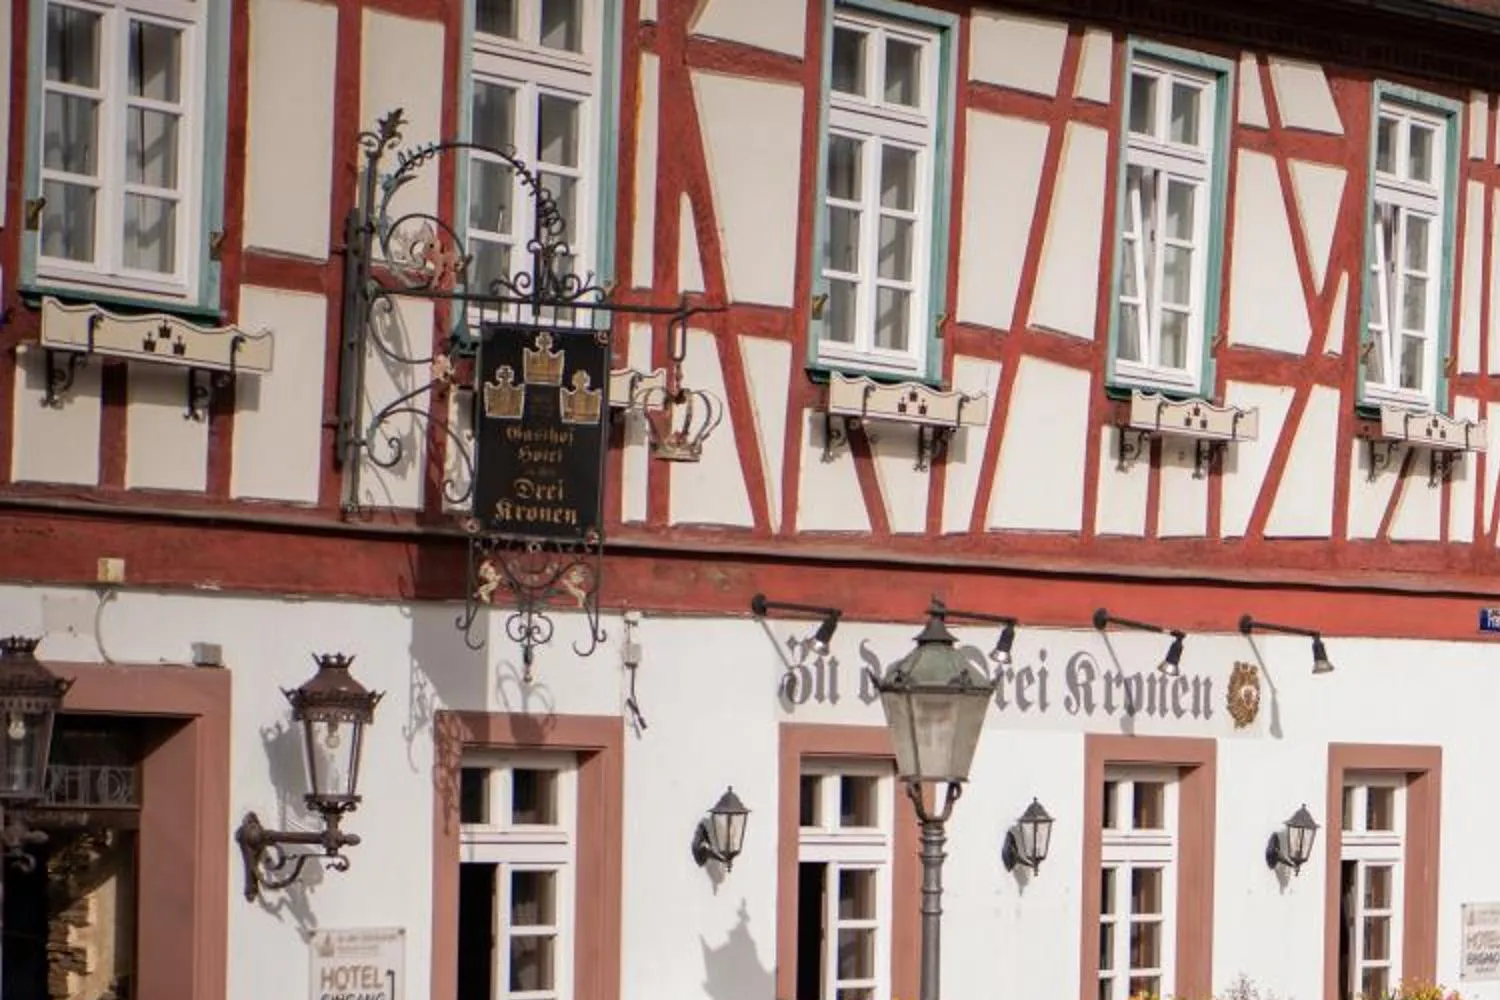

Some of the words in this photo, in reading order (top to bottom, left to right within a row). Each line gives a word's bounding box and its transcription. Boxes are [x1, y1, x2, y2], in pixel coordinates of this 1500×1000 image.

[505, 426, 575, 446] Gasthof
[513, 477, 565, 500] Drei
[495, 498, 577, 526] Kronen
[1064, 651, 1214, 720] Kronen
[321, 964, 384, 990] HOTEL
